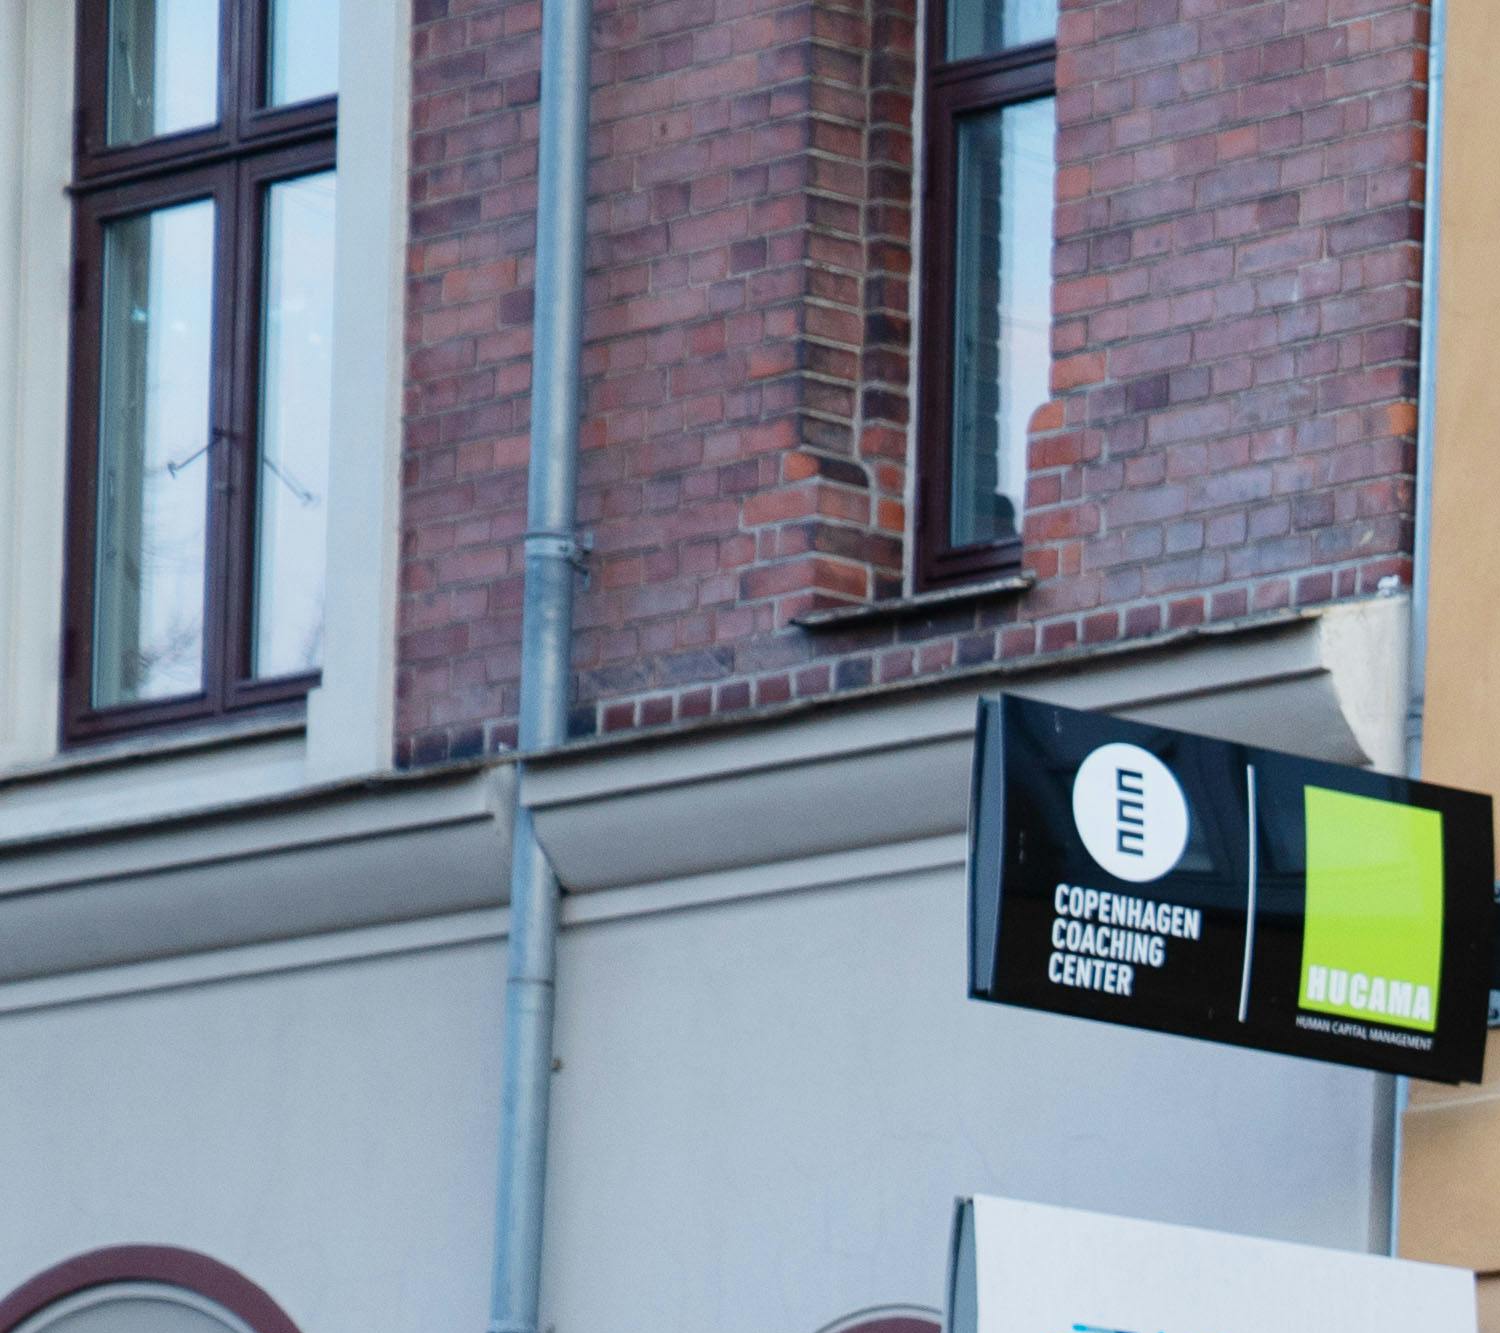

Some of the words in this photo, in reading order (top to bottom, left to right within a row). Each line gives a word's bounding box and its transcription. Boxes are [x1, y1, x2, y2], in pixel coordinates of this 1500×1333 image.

[1054, 883, 1201, 942] COPENHAGEN
[1051, 917, 1165, 968] COACHING
[1048, 952, 1135, 998] CENTER
[1306, 964, 1432, 1021] HUCAMA
[1296, 1015, 1330, 1033] HUMAN
[1332, 1021, 1367, 1041] CAPITAL
[1369, 1028, 1433, 1051] MANAGEMENT
